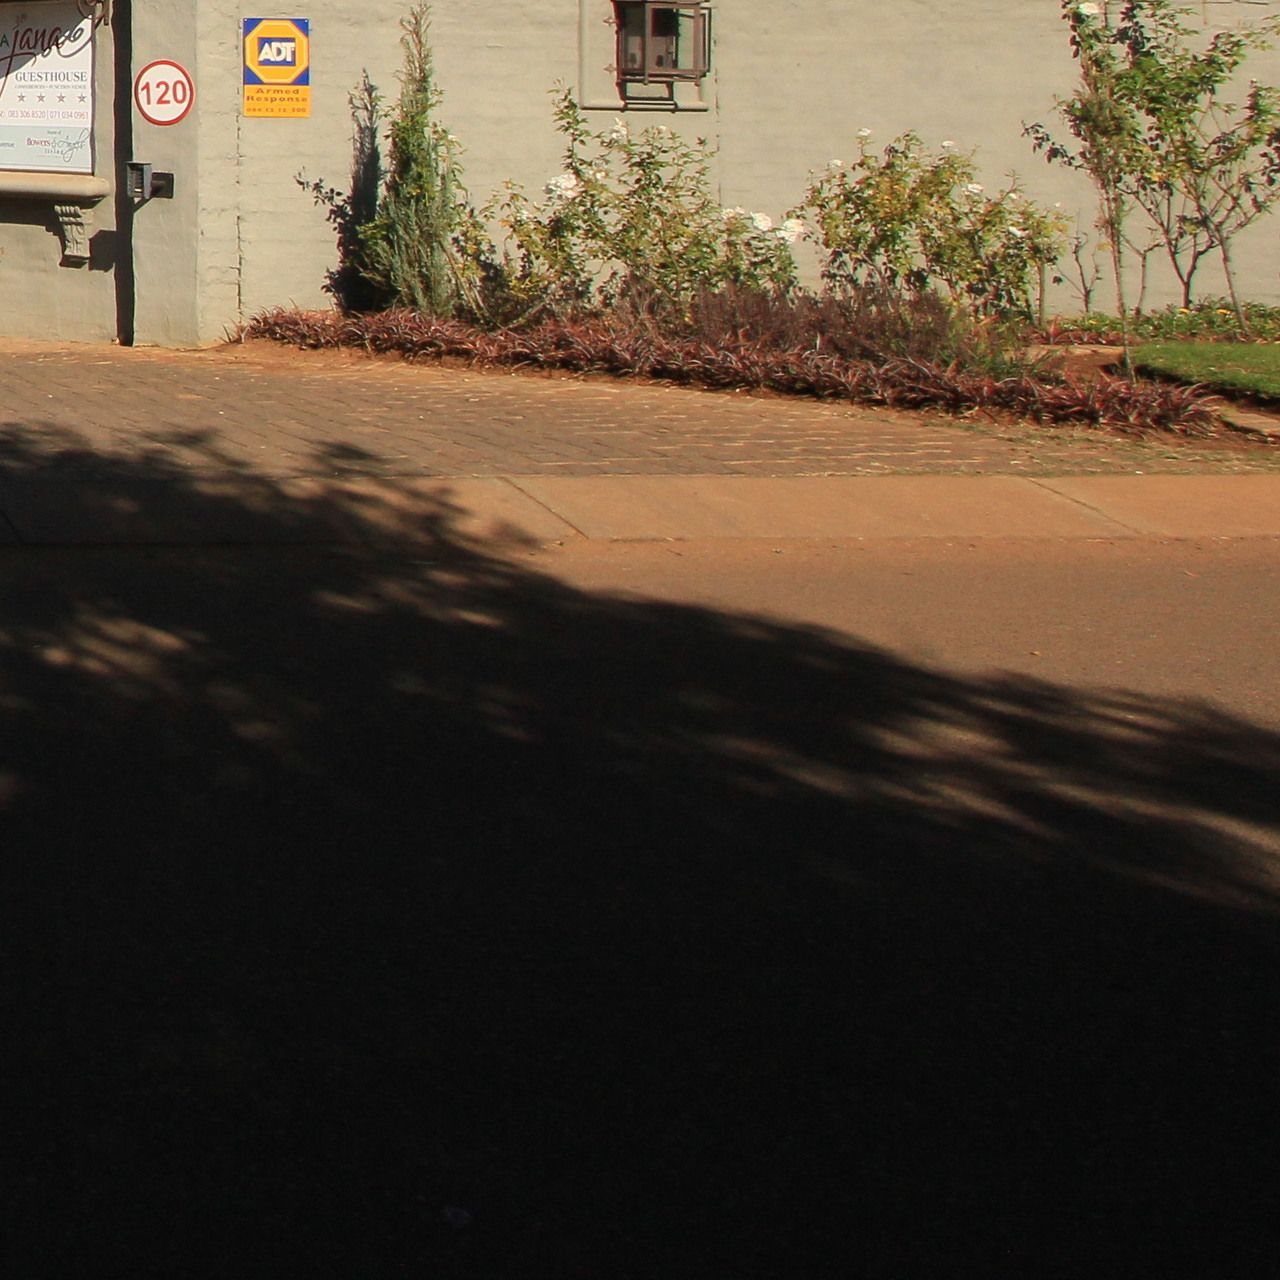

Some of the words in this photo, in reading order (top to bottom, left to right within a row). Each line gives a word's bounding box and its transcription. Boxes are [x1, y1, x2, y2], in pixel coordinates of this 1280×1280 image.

[258, 41, 296, 62] ADT
[15, 71, 88, 82] GUESTHOUSE
[141, 79, 188, 105] 120
[246, 95, 308, 104] Response
